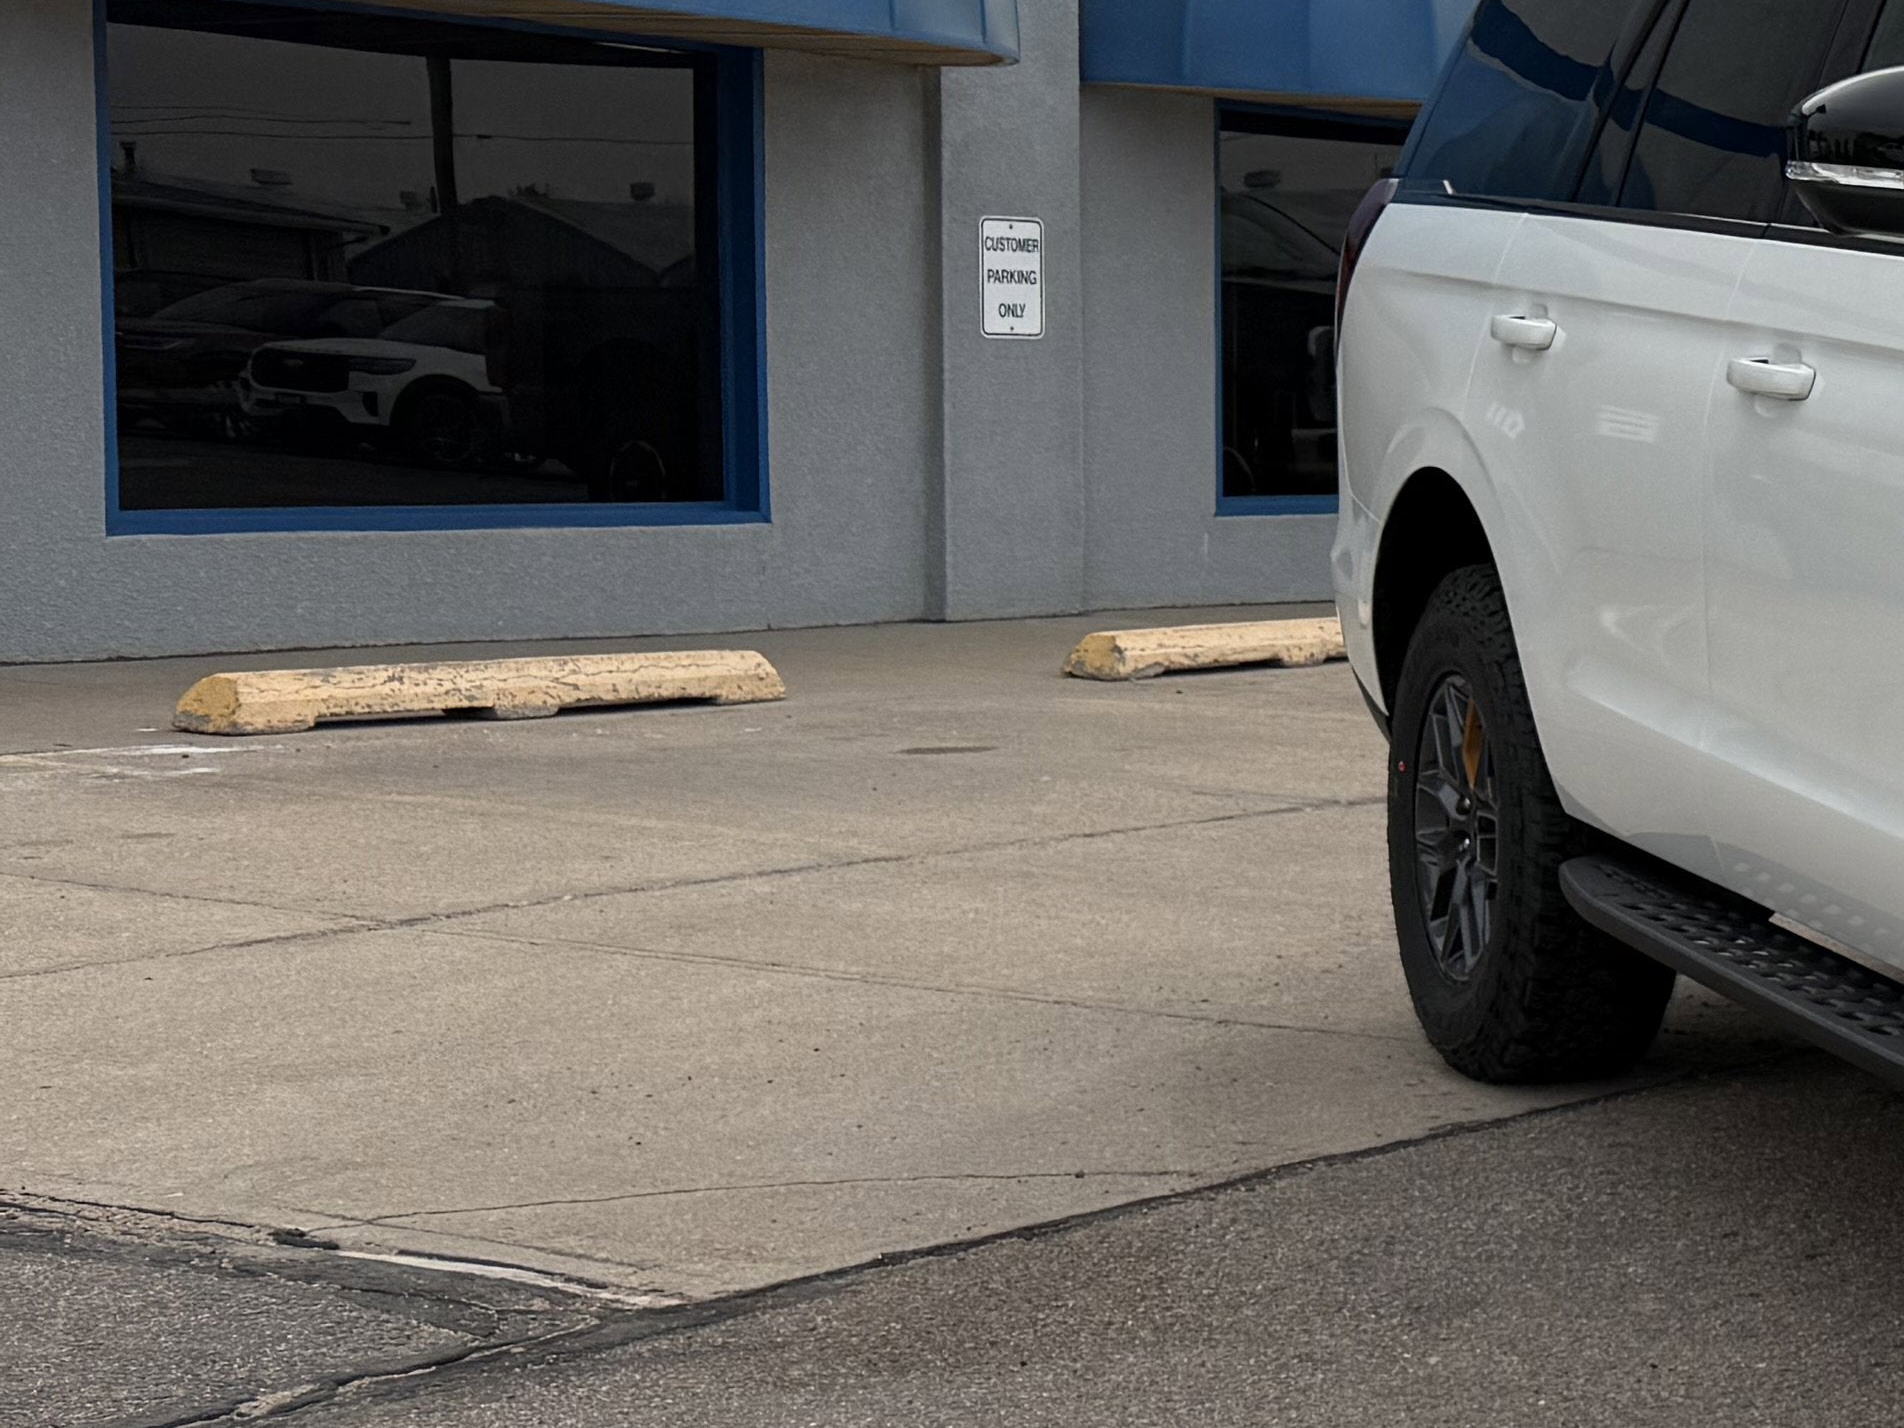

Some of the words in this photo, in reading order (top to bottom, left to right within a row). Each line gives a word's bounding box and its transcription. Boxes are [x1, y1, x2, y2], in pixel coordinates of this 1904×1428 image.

[984, 236, 1039, 253] CUSTOMER
[987, 268, 1037, 285] PARKING
[998, 303, 1026, 318] ONLY
